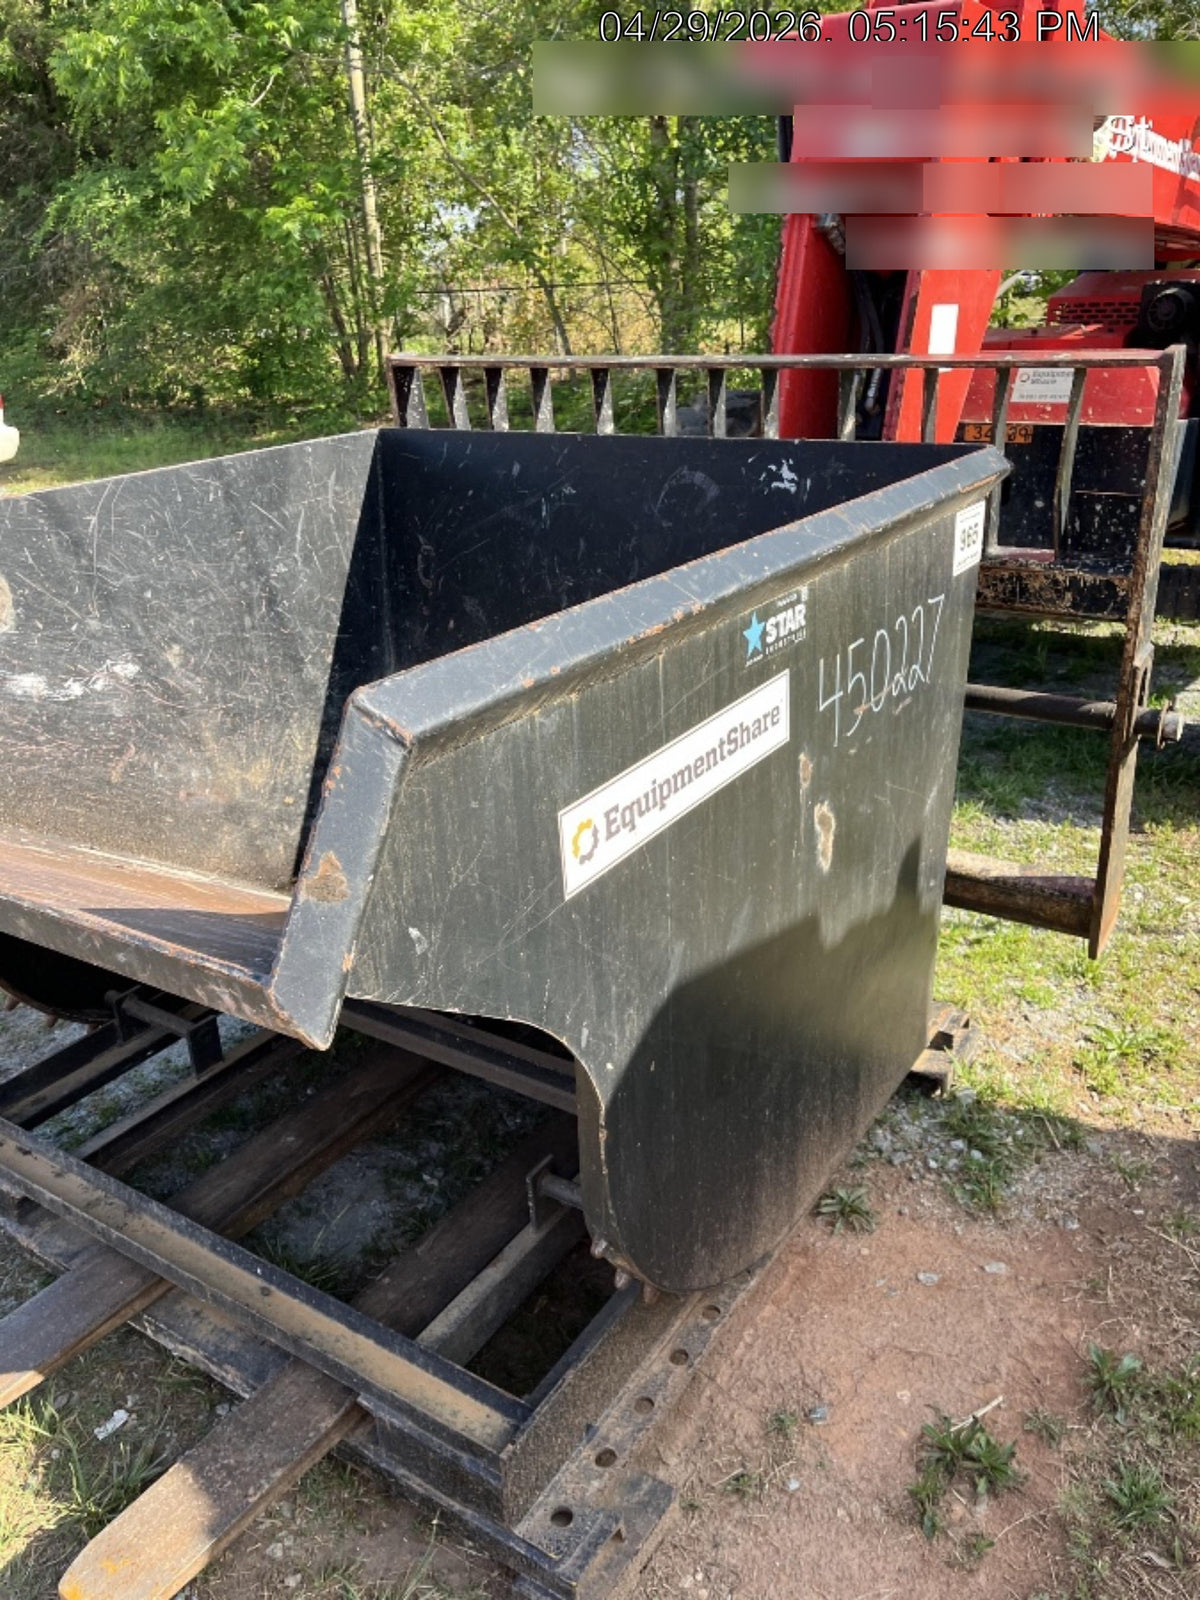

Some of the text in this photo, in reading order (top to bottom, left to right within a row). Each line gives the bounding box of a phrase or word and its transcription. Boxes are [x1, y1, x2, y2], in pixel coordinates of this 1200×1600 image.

[765, 603, 806, 644] STAR
[818, 593, 945, 748] 450227
[604, 703, 781, 842] EquipmentShare
